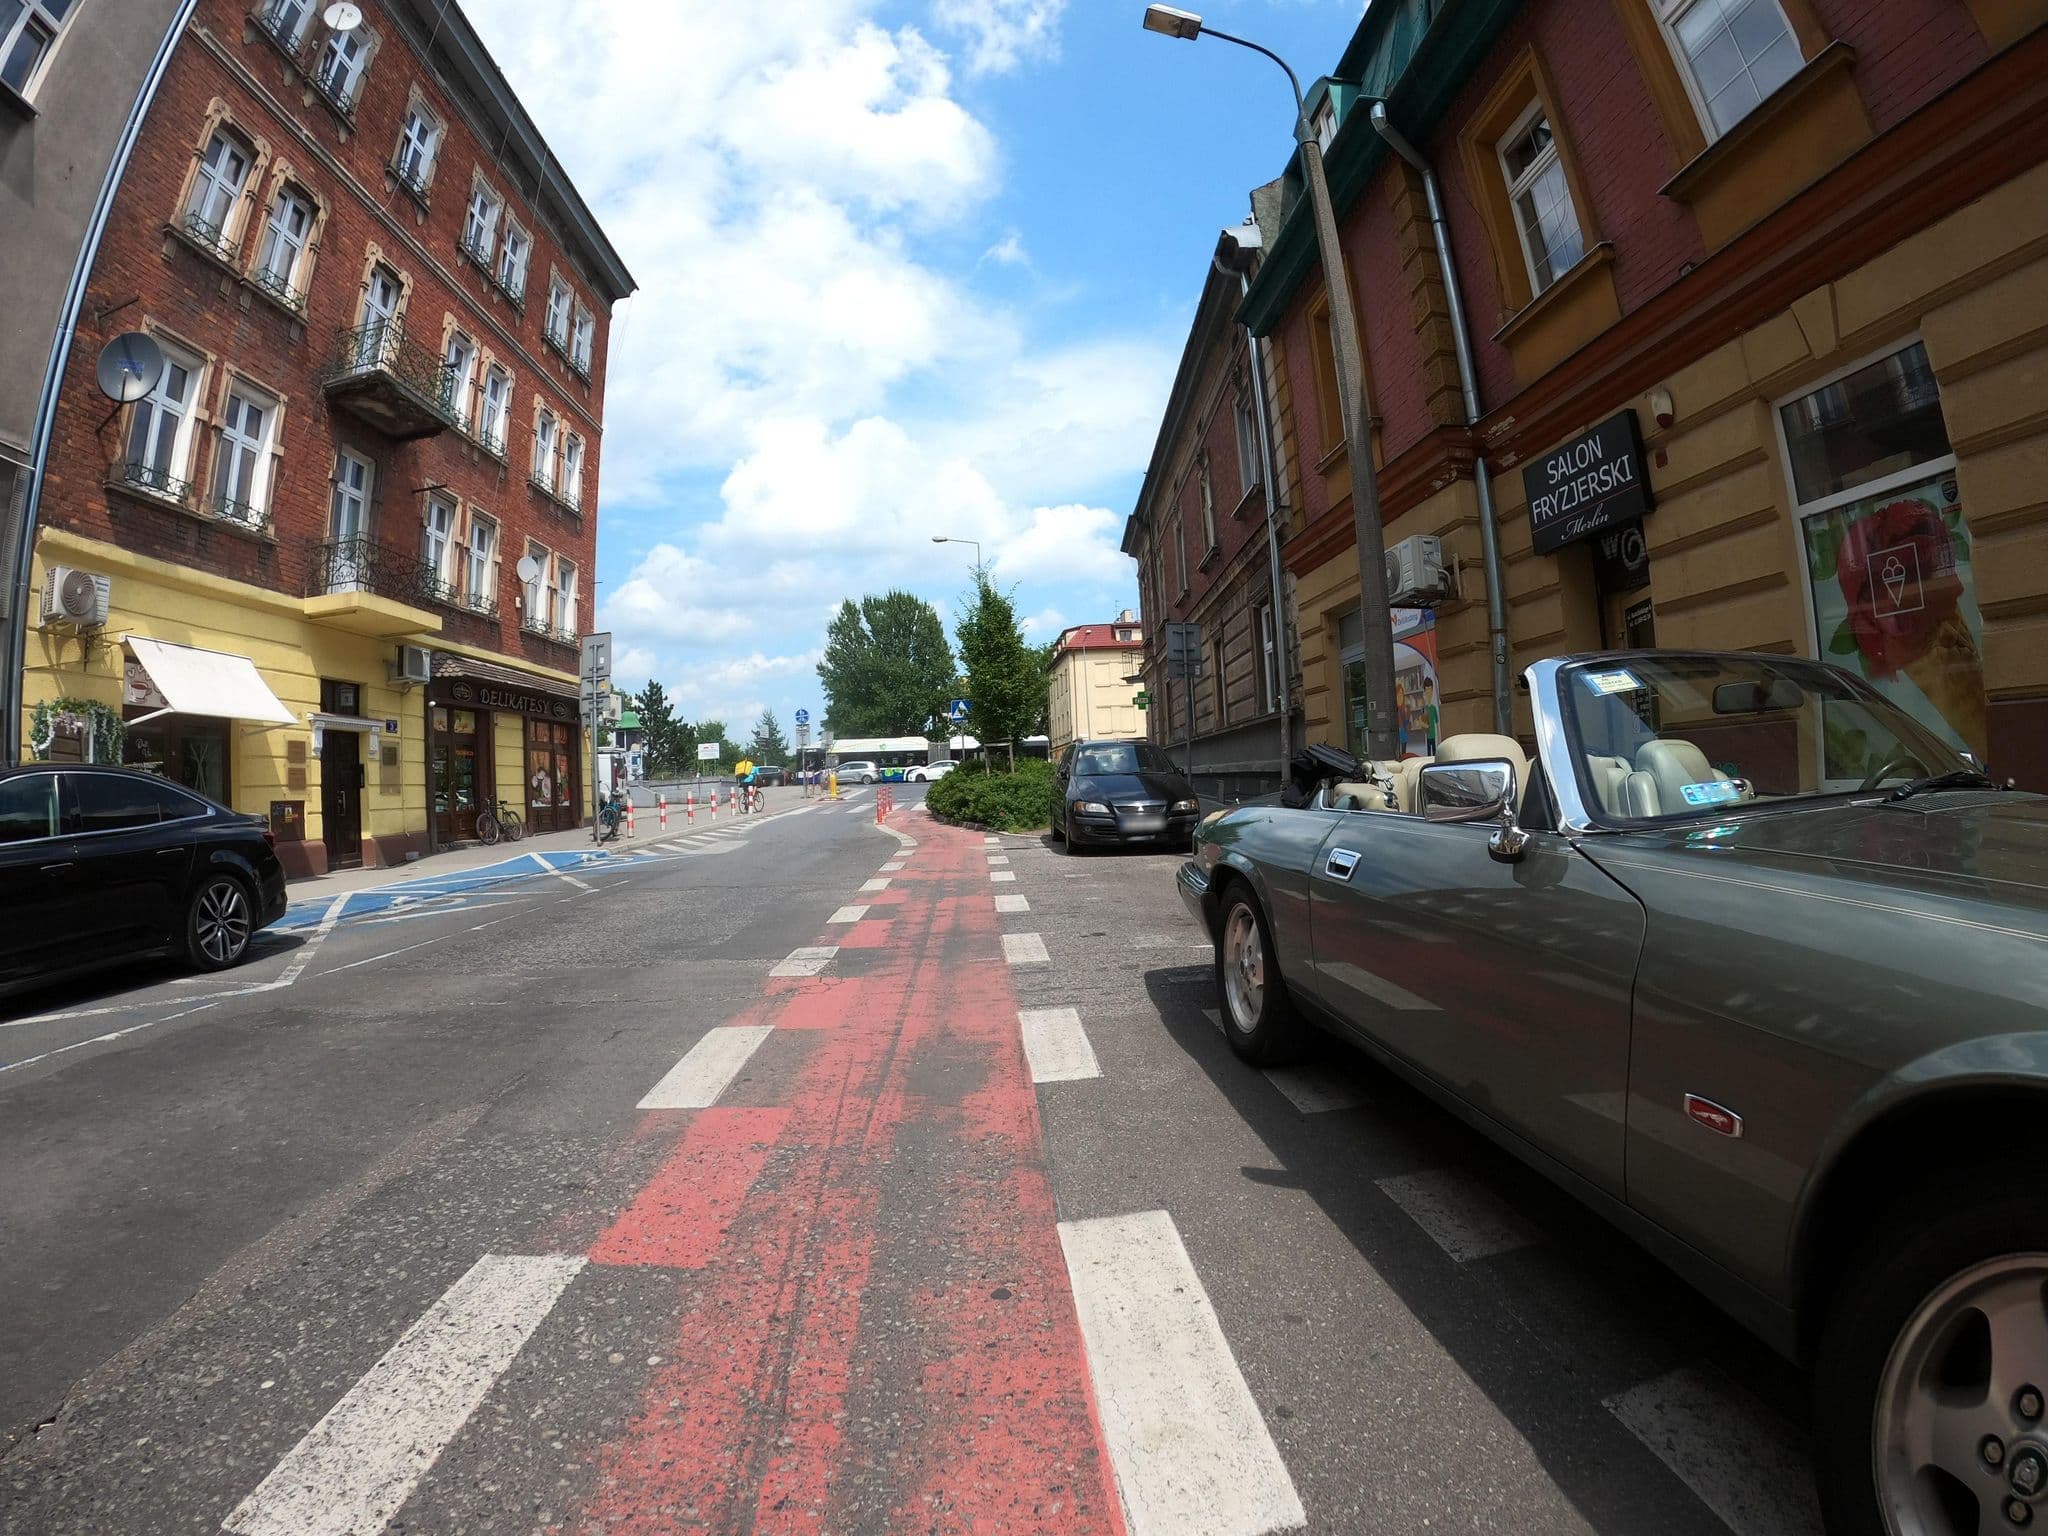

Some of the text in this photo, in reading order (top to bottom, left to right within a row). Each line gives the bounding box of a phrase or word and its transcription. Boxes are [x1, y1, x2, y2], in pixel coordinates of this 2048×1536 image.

[1546, 434, 1603, 485] SALON
[1531, 454, 1633, 524] FRYZJERSKI
[1560, 502, 1610, 541] Merlin
[479, 688, 549, 714] DELIKATESY
